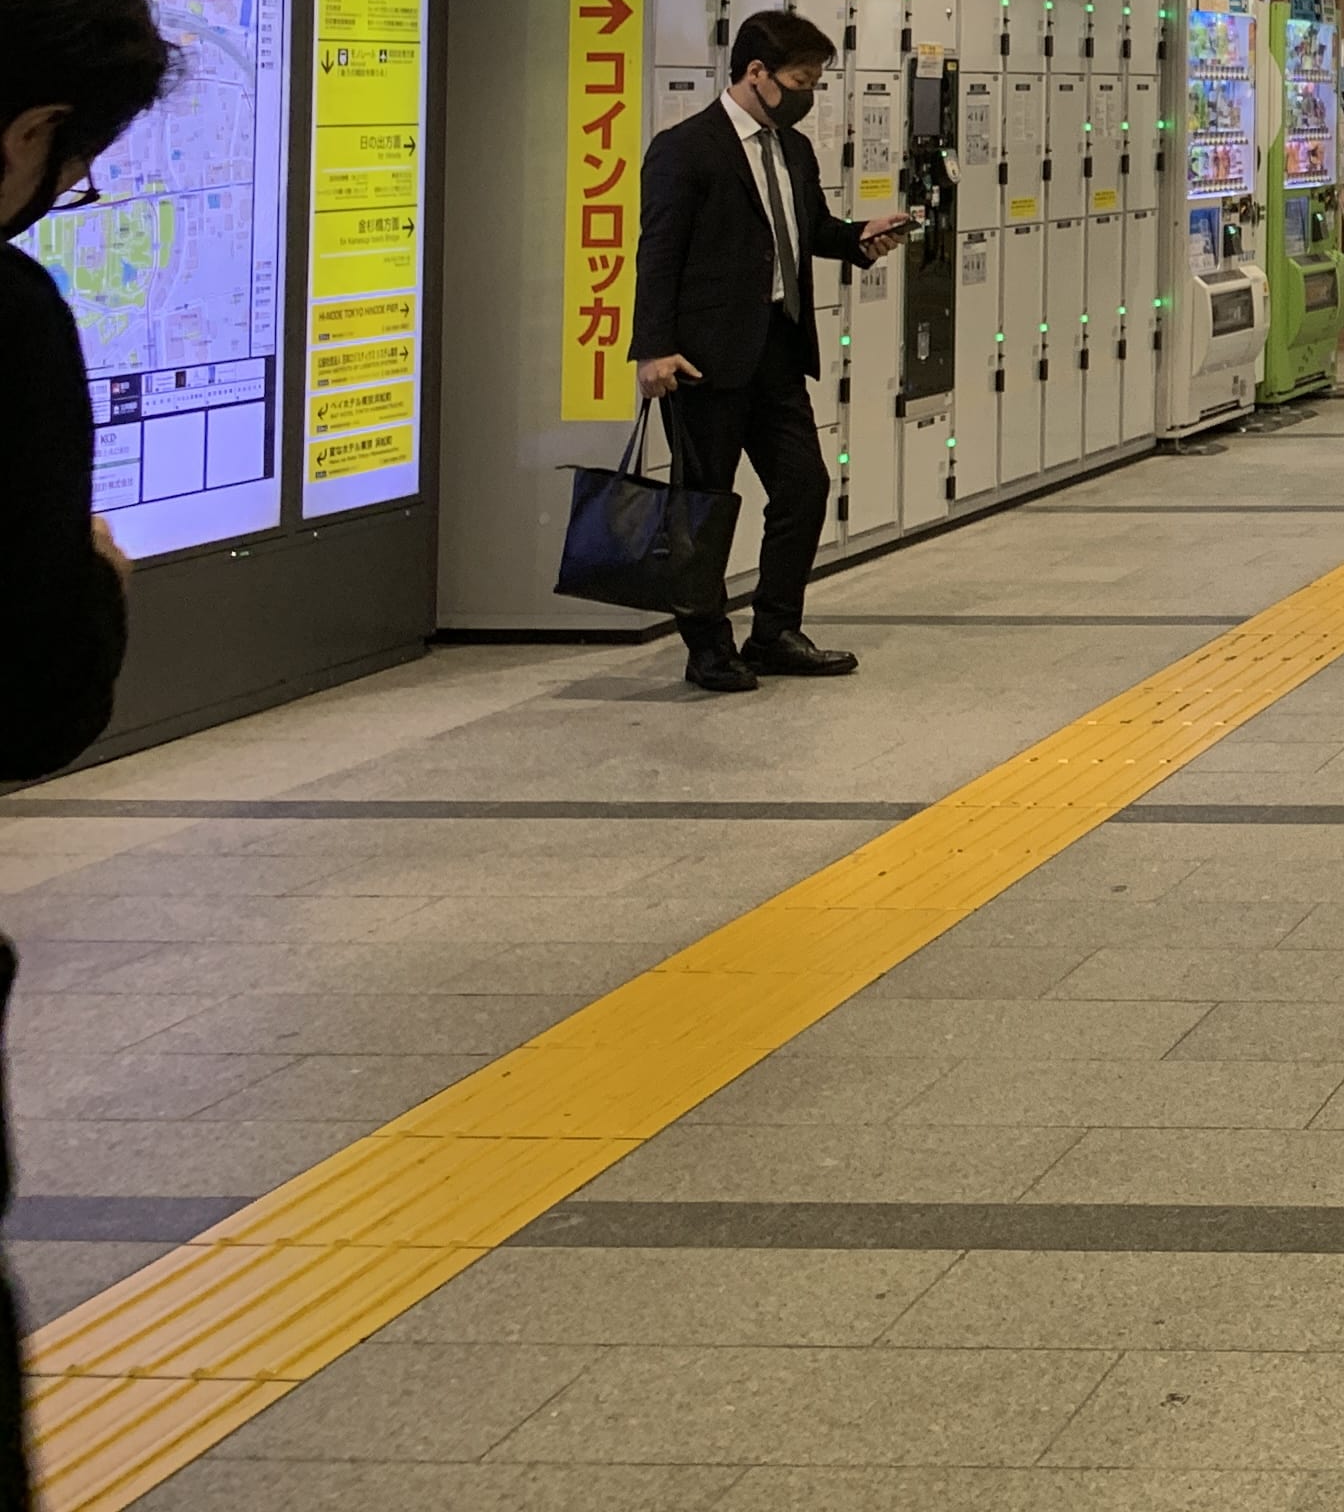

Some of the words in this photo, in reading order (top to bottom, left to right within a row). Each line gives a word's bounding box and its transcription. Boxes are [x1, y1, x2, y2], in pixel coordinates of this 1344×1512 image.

[577, 51, 626, 402] コインロッカー
